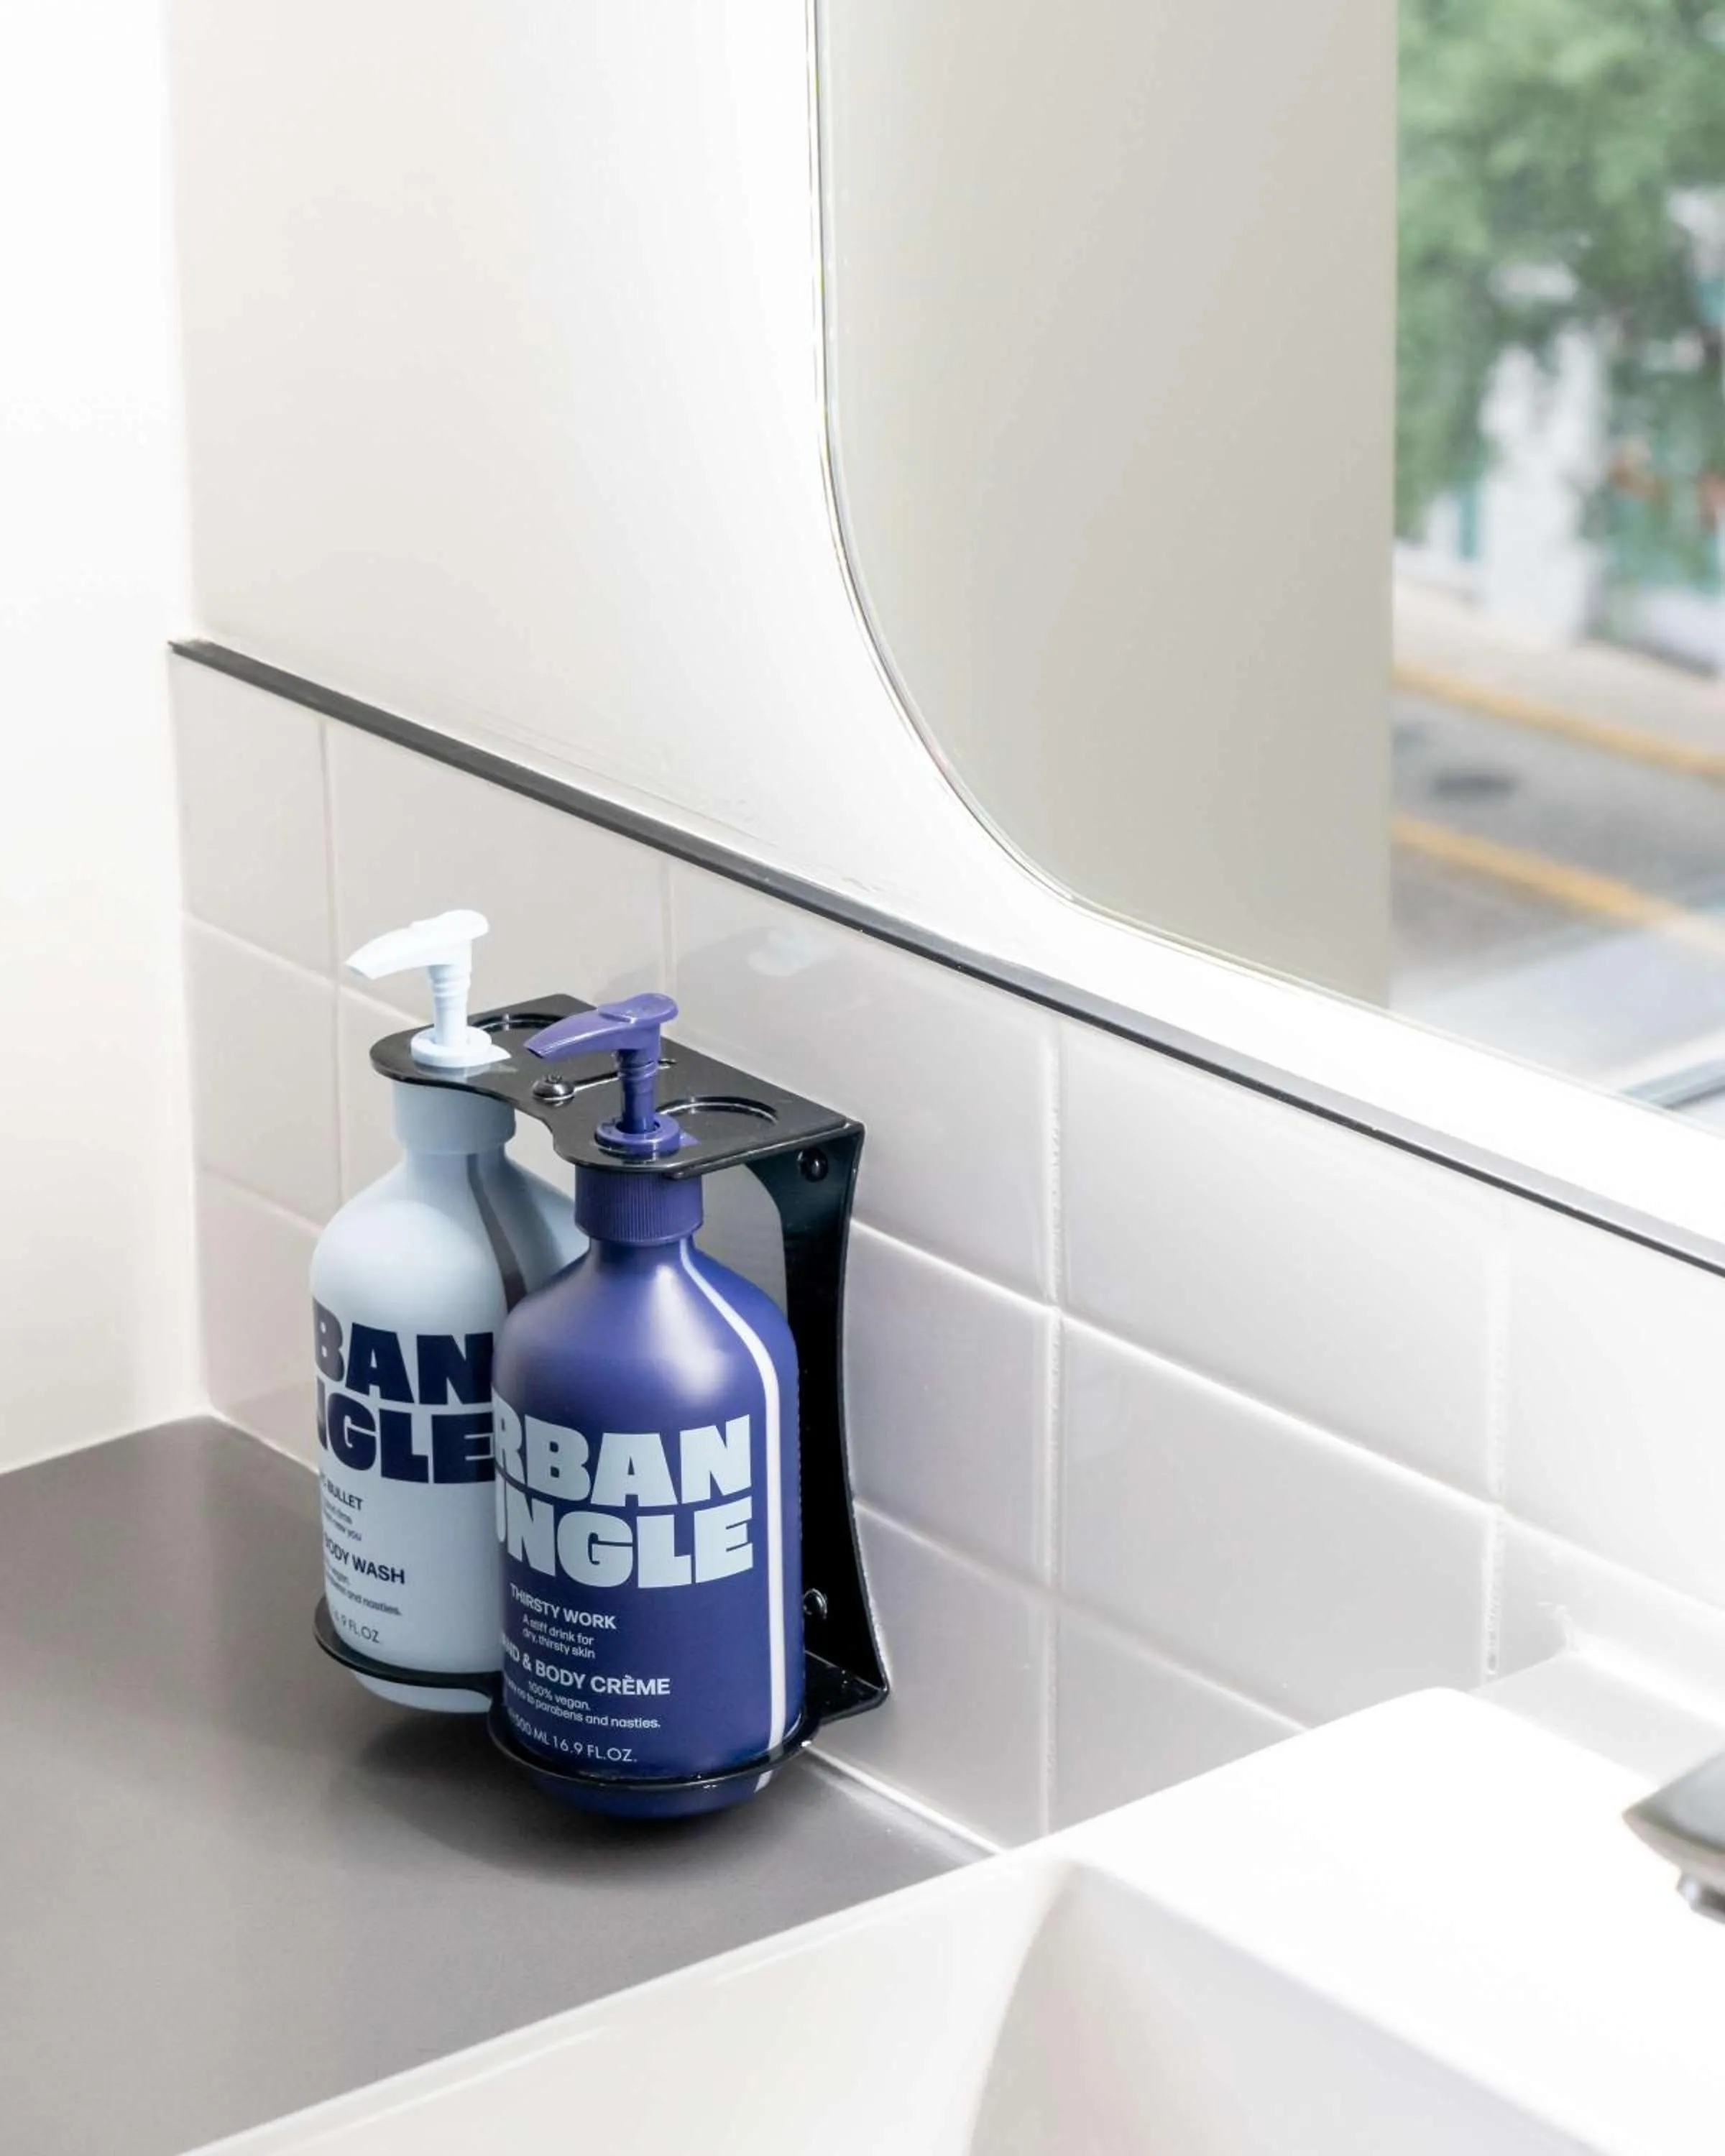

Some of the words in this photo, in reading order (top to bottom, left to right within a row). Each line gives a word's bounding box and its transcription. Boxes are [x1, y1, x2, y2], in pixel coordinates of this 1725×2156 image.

[317, 1376, 496, 1484] GLE
[351, 1553, 406, 1585] WASH
[510, 1583, 561, 1618] THIRSTY
[562, 1608, 617, 1630] WORK
[539, 1634, 570, 1655] thirsty
[571, 1646, 596, 1659] skin
[548, 1626, 575, 1643] drink
[577, 1633, 596, 1646] for
[523, 1653, 532, 1671] &
[535, 1659, 586, 1690] BODY
[590, 1674, 671, 1695] CRÈME
[535, 1699, 584, 1723] parabens
[585, 1715, 609, 1726] and
[610, 1718, 661, 1728] nasties.
[554, 1694, 591, 1710] vegan.
[533, 1728, 551, 1746] ML
[553, 1736, 583, 1755] 16.9
